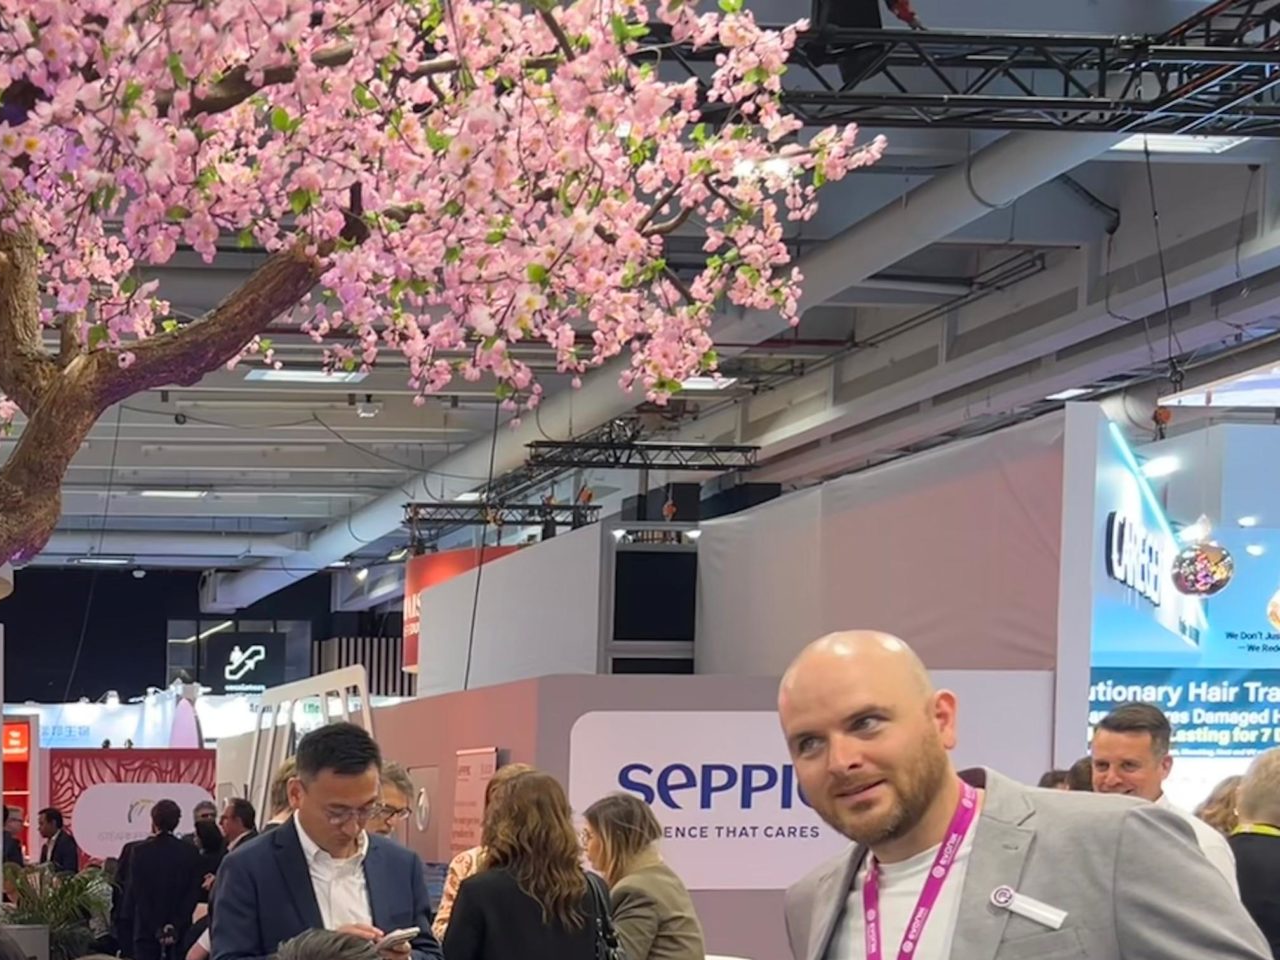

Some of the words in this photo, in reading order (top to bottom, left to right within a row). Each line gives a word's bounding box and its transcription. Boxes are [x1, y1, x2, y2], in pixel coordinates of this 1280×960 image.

[1188, 680, 1239, 703] Hair
[1192, 708, 1269, 727] Damaged
[1231, 726, 1259, 743] for
[1261, 727, 1272, 743] 7
[617, 763, 813, 810] SePPI
[663, 825, 709, 839] ENCE
[714, 825, 759, 839] THAT
[763, 825, 820, 839] CARES
